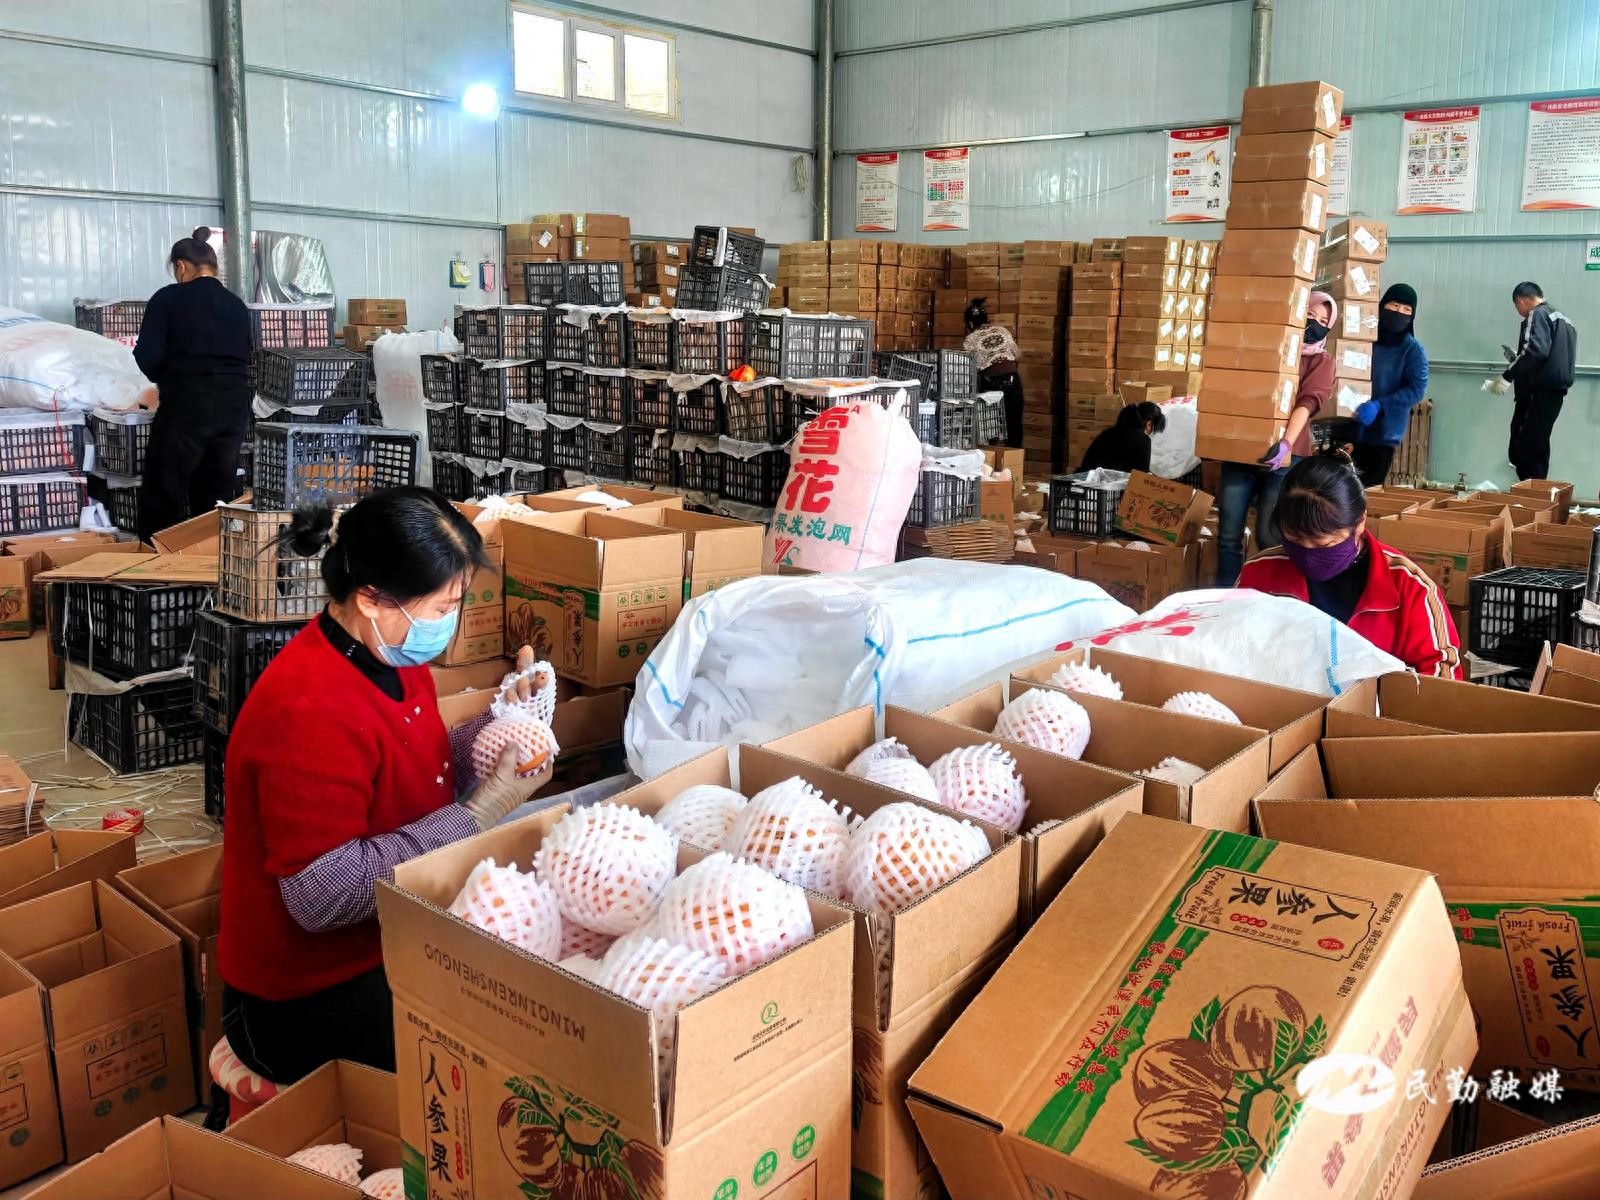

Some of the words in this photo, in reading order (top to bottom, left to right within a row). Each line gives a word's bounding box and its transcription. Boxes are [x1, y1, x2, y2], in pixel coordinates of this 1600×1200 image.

[785, 407, 849, 513] 雪花
[1184, 894, 1207, 919] fruit
[1199, 871, 1226, 900] Fresh
[1228, 876, 1360, 925] 人参果
[424, 943, 586, 1042] MINQINRENSHENGUO
[1539, 945, 1593, 1059] 人参果
[423, 1052, 452, 1184] 人参果
